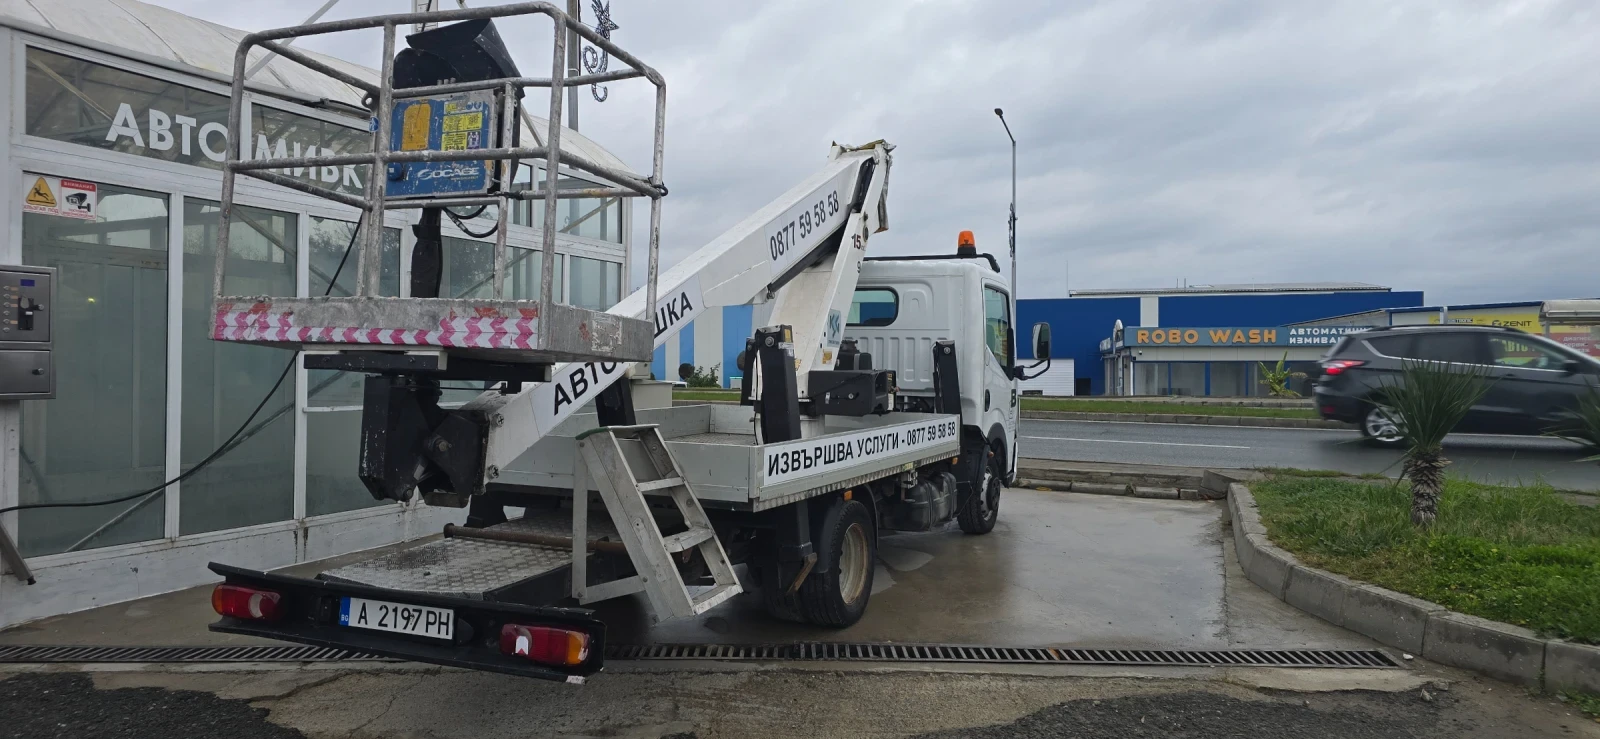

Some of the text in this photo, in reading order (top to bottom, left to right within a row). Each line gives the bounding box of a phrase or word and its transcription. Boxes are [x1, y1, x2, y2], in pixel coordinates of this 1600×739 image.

[105, 102, 366, 189] АВТО МИВК
[417, 167, 480, 180] SOCAGE
[770, 190, 839, 261] 0877 59 58 58
[1137, 329, 1277, 344] ROBO WASH
[768, 441, 854, 477] ИЗВЪРШВА
[857, 432, 899, 458] УСЛУГИ
[906, 427, 926, 446] 0877
[927, 426, 937, 441] 59
[938, 423, 946, 438] 58
[947, 421, 956, 436] 58
[358, 602, 450, 635] A 2197 PH
